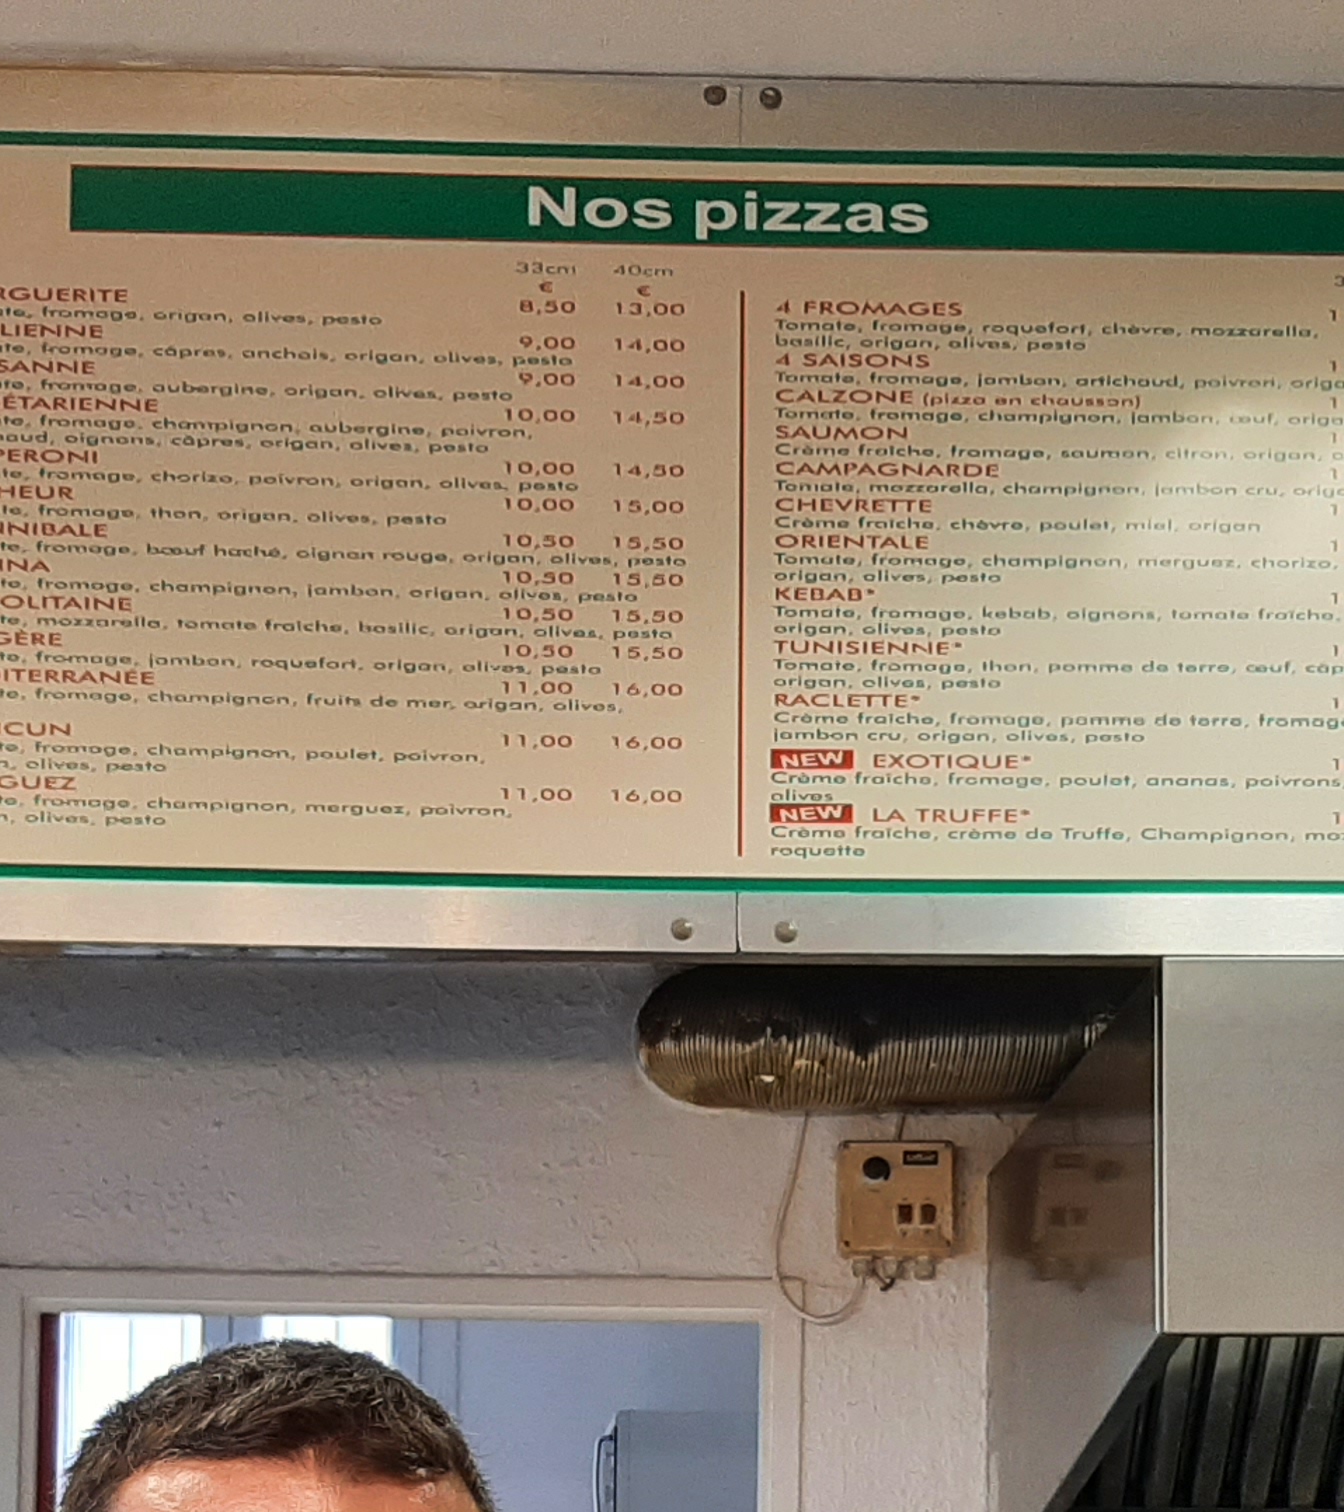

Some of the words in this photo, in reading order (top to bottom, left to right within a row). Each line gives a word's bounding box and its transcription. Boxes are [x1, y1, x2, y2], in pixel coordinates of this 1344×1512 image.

[528, 185, 673, 229] Nos
[695, 190, 929, 241] pizzas
[519, 299, 576, 316] 8,50
[616, 301, 685, 318] 13,00
[776, 299, 791, 315] 4
[803, 300, 963, 317] FROMAGES
[775, 352, 791, 367] 4
[802, 352, 930, 369] SAISONS
[775, 388, 914, 405] CALZONE
[775, 424, 908, 442] SAUMON
[775, 461, 999, 479] CAMPAGNARDE
[774, 497, 932, 514] CHEVRETTE
[774, 533, 929, 550] ORIENTALE
[778, 749, 844, 768] NEW
[500, 787, 573, 804] 11,00
[611, 788, 683, 805] 16,00
[778, 804, 843, 823] NEW
